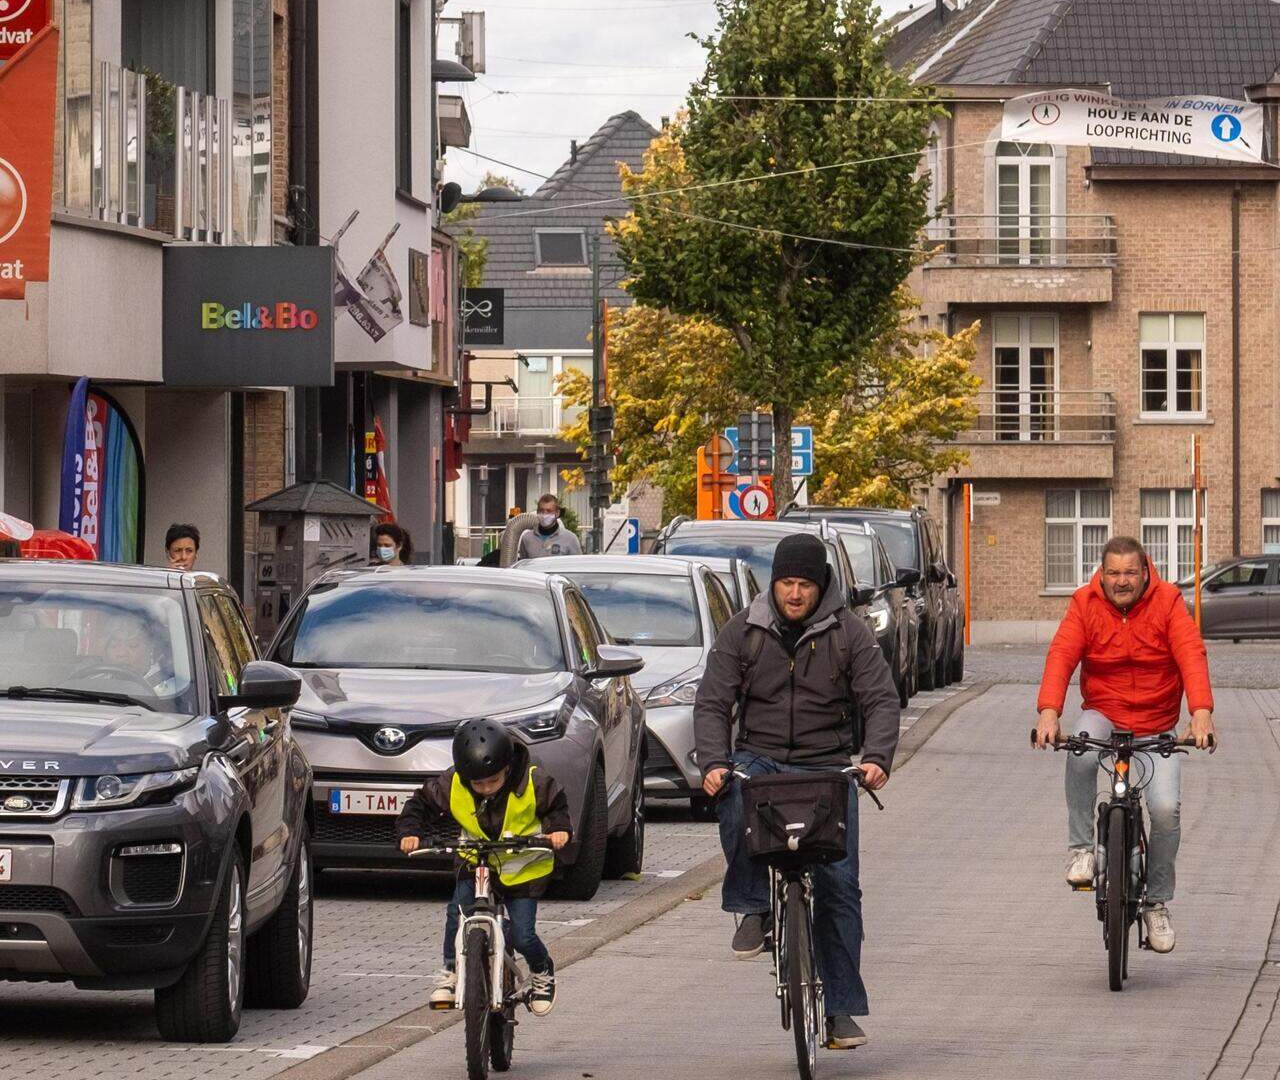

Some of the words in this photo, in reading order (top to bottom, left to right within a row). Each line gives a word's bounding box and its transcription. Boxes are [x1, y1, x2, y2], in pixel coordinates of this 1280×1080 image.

[1025, 94, 1070, 104] VEILIG
[1074, 94, 1147, 109] WINKELEN
[1164, 99, 1178, 108] IN
[1183, 100, 1244, 115] BORNEM
[1088, 108, 1117, 119] HOU
[1122, 111, 1136, 121] JE
[1142, 113, 1169, 124] AAN
[1175, 115, 1192, 126] DE
[1086, 124, 1192, 145] LOOPRICHTING
[202, 302, 318, 329] Bel&Bo
[81, 399, 99, 545] Bel&Bo
[345, 794, 412, 810] 1-TAM-
